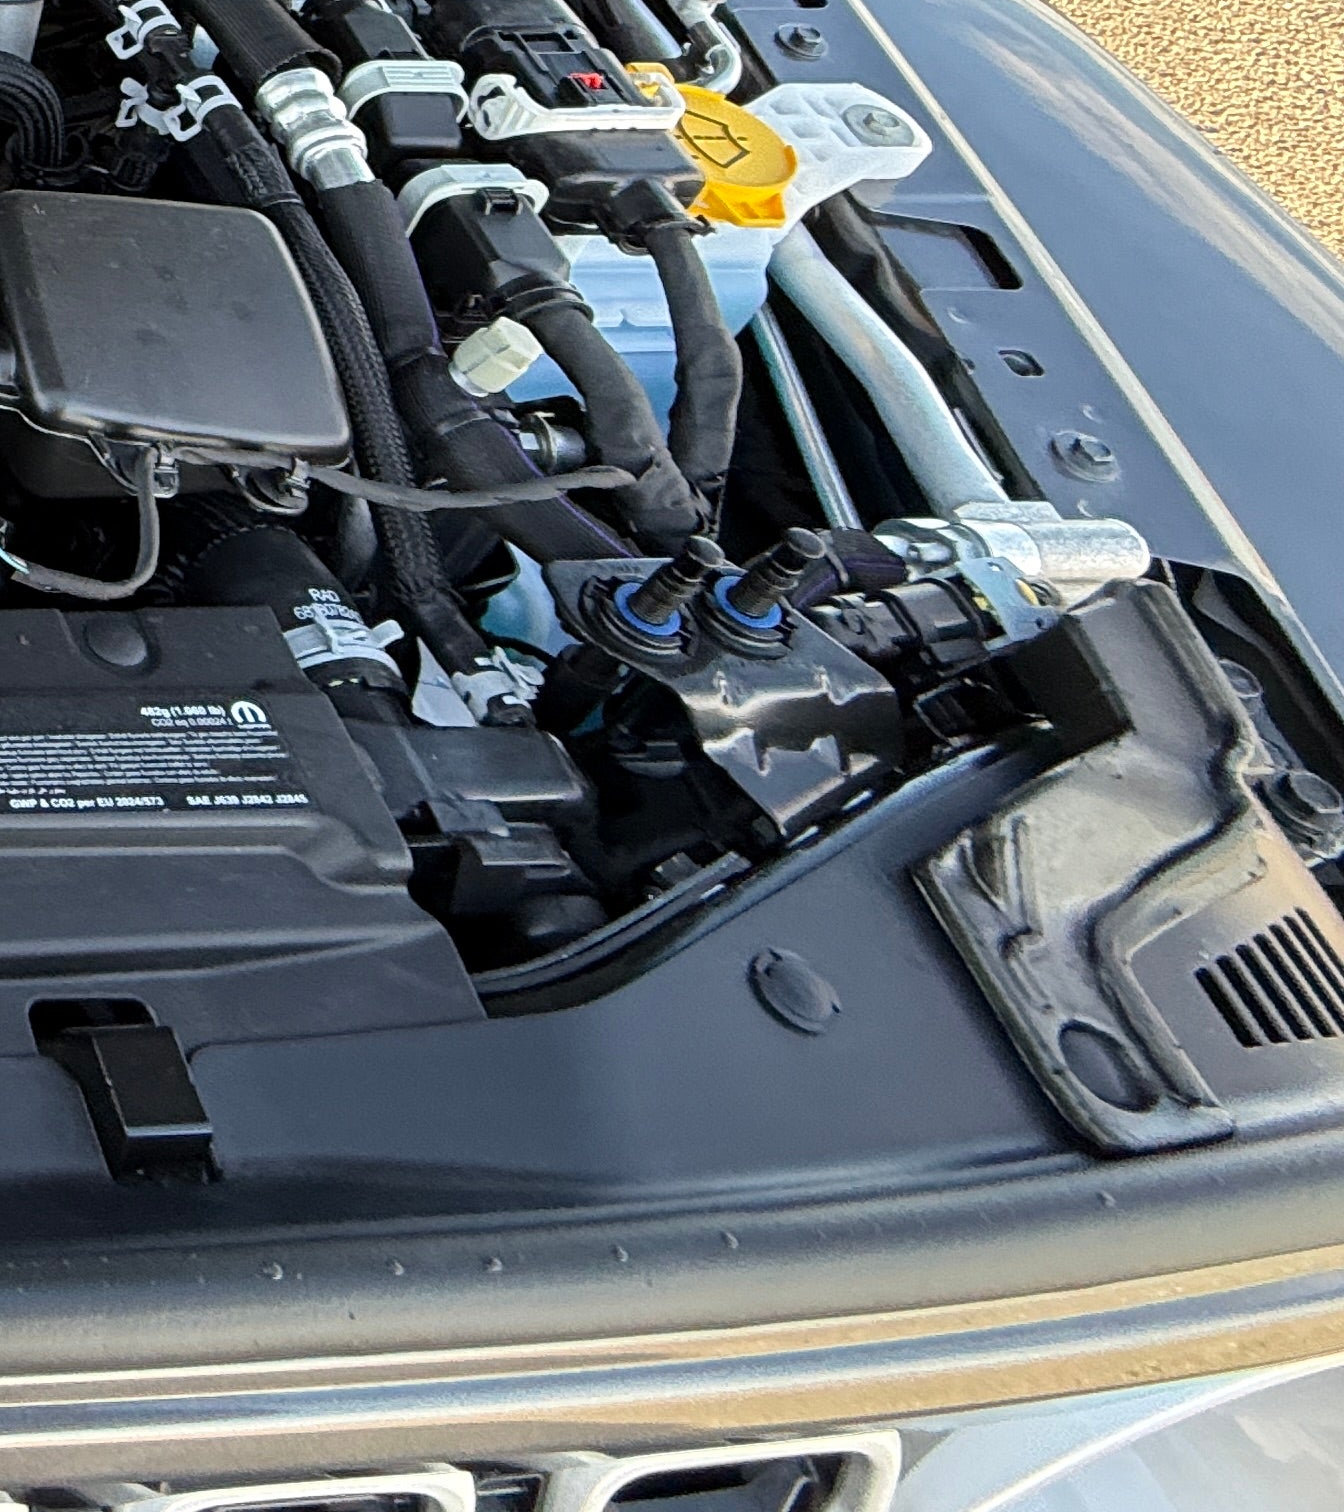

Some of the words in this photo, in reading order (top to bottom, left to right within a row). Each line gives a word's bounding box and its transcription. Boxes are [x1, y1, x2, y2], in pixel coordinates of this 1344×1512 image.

[308, 588, 341, 603] RAD
[9, 798, 37, 809] GWP
[50, 798, 76, 808] CO2
